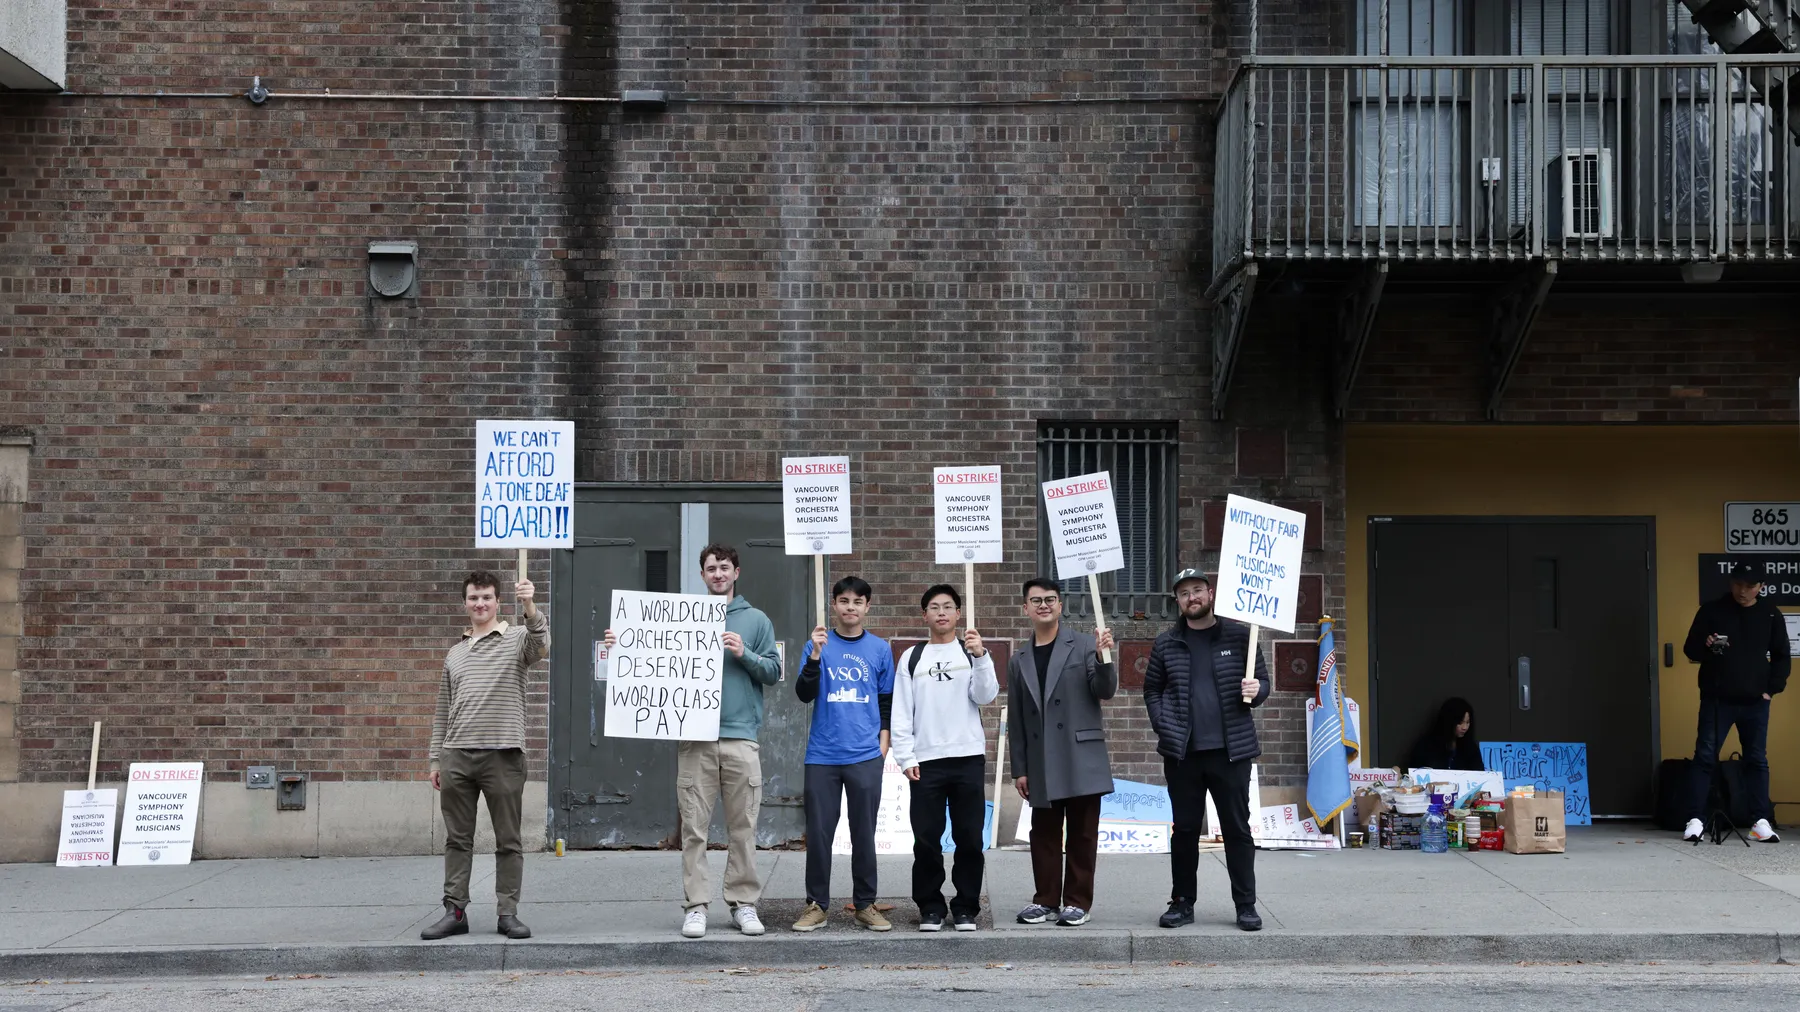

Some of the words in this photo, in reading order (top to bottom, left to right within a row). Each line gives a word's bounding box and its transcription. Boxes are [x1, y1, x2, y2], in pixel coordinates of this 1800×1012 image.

[493, 431, 517, 446] WE
[521, 430, 561, 448] CAN'T
[484, 451, 554, 477] AFFORD
[785, 465, 802, 474] ON
[805, 464, 846, 473] STRIKE!
[937, 474, 954, 483] ON
[957, 473, 998, 482] STRIKE!
[482, 482, 492, 501] A
[495, 482, 532, 502] TONE
[536, 482, 570, 502] DEAF
[1047, 487, 1064, 498] ON
[1066, 479, 1108, 495] STRIKE!
[1058, 502, 1104, 516] VANCOUVER
[1752, 508, 1788, 525] 865
[480, 505, 569, 539] BOARD!!
[1062, 513, 1104, 526] SYMPHONY
[1230, 508, 1276, 532] WITHOUT
[1278, 520, 1299, 538] FAIR
[1062, 523, 1106, 536] ORCHESTRA
[1730, 529, 1800, 546] SEYMOU
[1066, 533, 1107, 546] MUSICIANS
[1249, 531, 1277, 558] PAY
[1236, 554, 1286, 579] MUSICIANS
[1241, 572, 1273, 591] WON'T
[616, 597, 627, 619] A
[1234, 588, 1279, 619] STAY!
[619, 628, 721, 651] ORCHESTRA
[618, 655, 716, 682] DESERVES
[827, 667, 862, 682] VSO
[843, 653, 869, 682] musicians
[636, 708, 688, 737] PAY
[1483, 747, 1548, 780] Unfair
[132, 771, 150, 779] ON
[154, 770, 199, 779] STRIKE!
[1284, 807, 1292, 821] ON
[1304, 821, 1314, 833] ON
